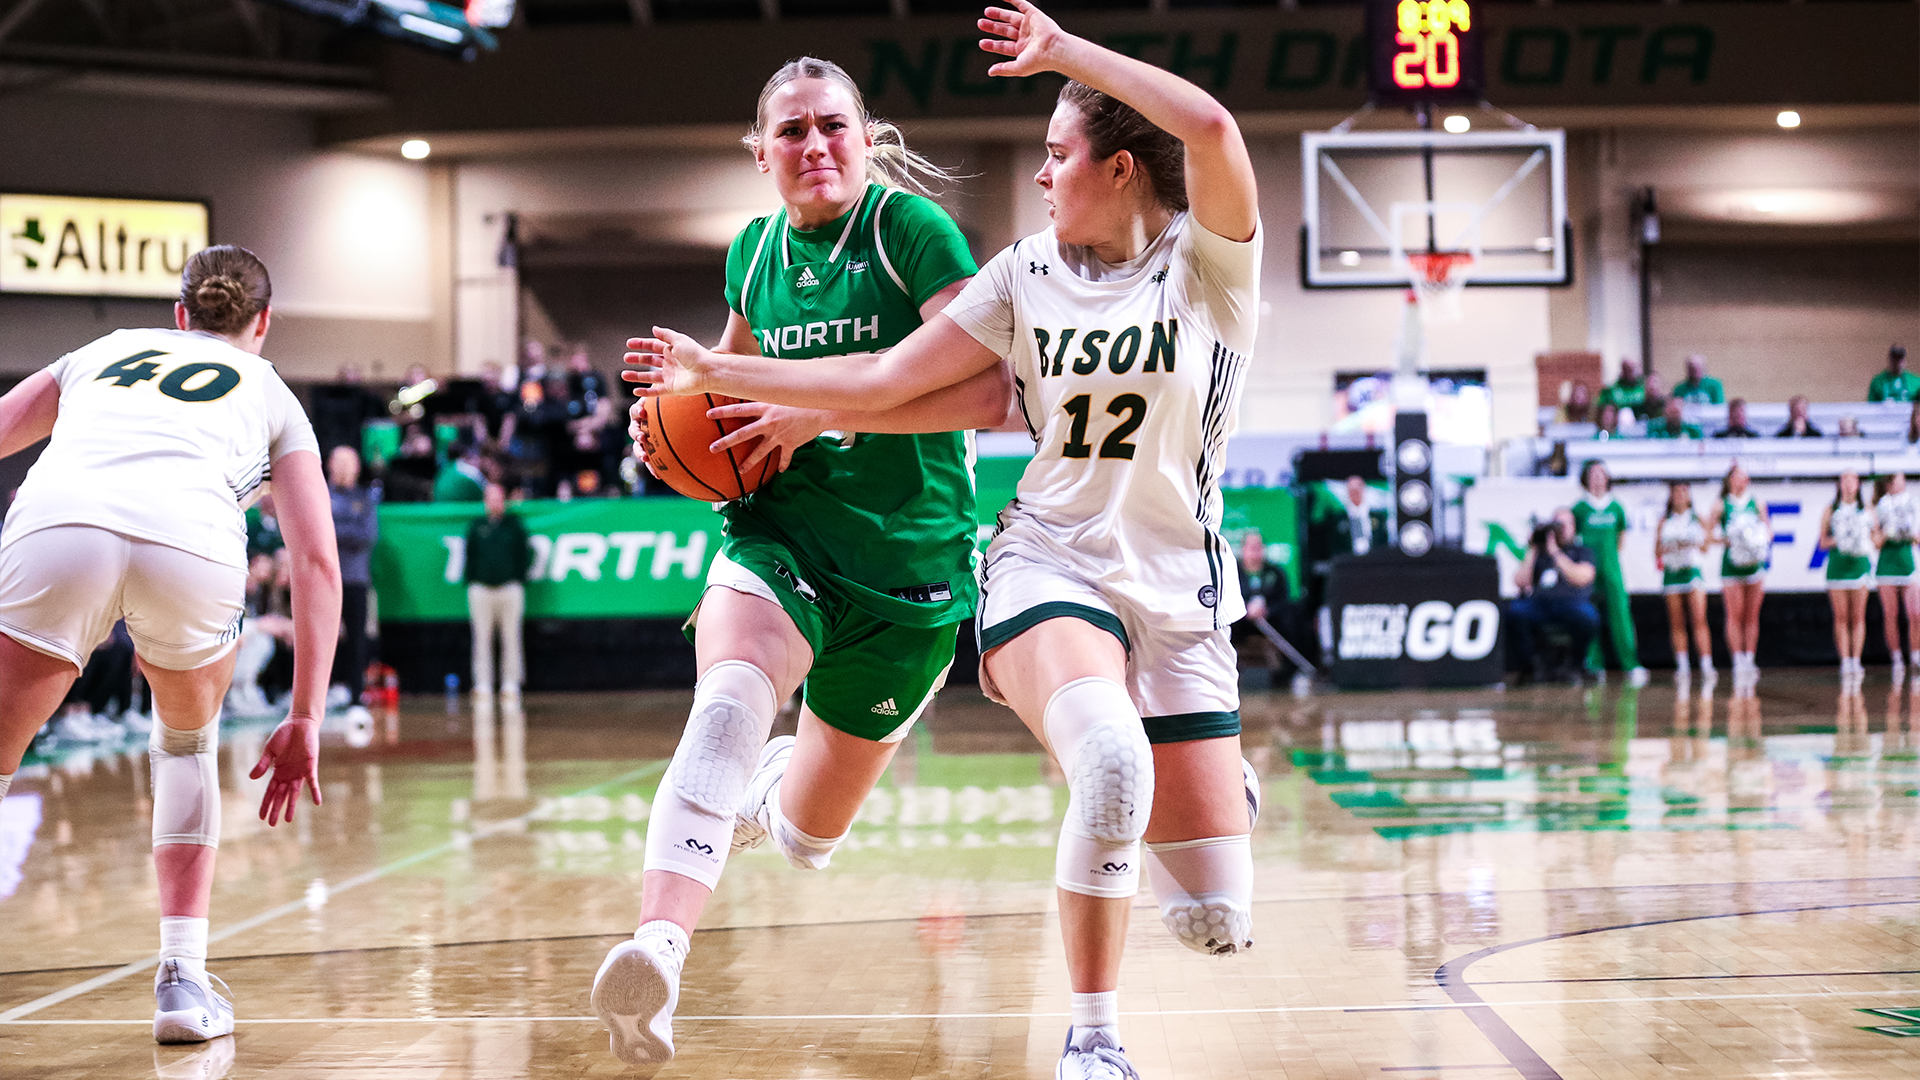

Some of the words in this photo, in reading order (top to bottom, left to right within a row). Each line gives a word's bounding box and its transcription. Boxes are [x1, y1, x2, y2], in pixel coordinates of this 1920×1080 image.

[866, 31, 1238, 109] NOTH
[1267, 25, 1715, 90] DOTA
[1393, 31, 1460, 88] 20
[53, 218, 188, 274] Altru
[796, 277, 820, 288] adidas
[761, 314, 879, 358] NORTH
[1033, 318, 1179, 378] BISON
[93, 349, 241, 403] 40
[1061, 392, 1148, 460] 12
[1405, 599, 1500, 661] GO
[870, 706, 899, 716] adidas
